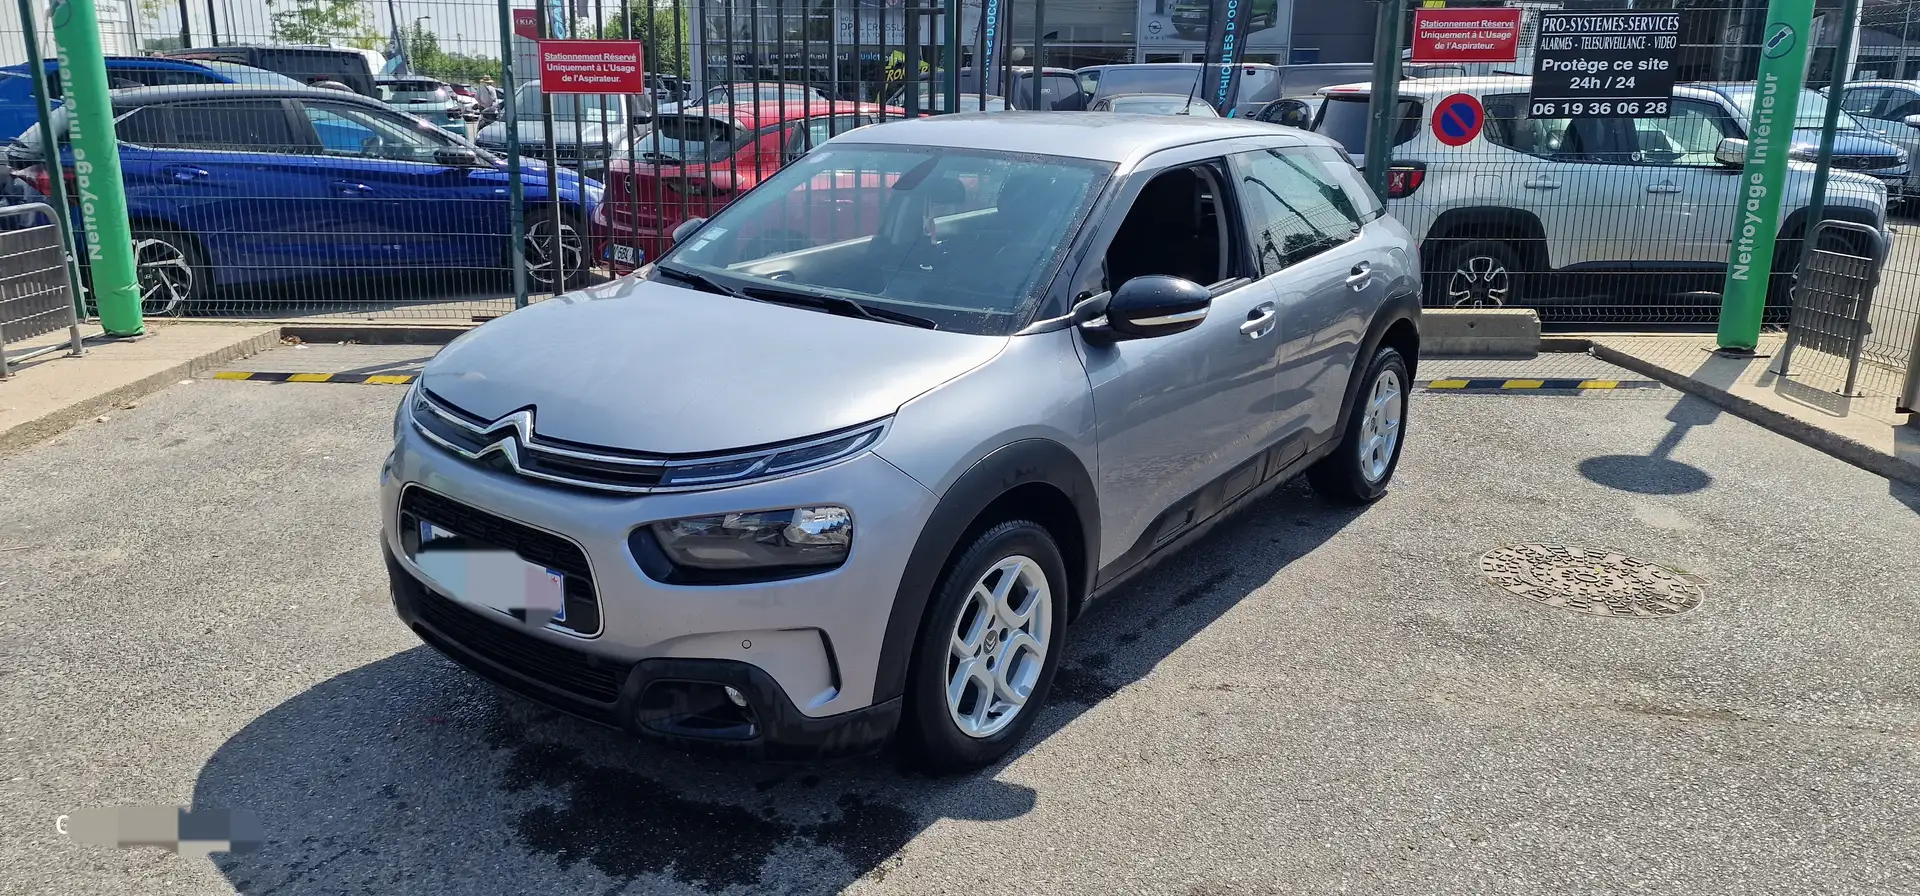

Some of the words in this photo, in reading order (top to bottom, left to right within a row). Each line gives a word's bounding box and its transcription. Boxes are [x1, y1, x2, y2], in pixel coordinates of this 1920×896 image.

[1420, 19, 1480, 28] Stationnement
[1481, 19, 1515, 28] Réservé
[1542, 16, 1680, 32] PRO-SYSTEMES-SERVICES
[1421, 30, 1471, 40] Uniquement
[1478, 31, 1512, 40] L'Usage
[1434, 42, 1445, 50] de
[1446, 42, 1495, 51] l'Aspirateur.
[1540, 36, 1573, 50] ALARMES
[1581, 36, 1646, 50] TELESURVEILLANCE
[1654, 36, 1677, 49] VIDEO
[546, 63, 595, 72] Uniquement
[603, 64, 636, 73] L'Usage
[1218, 33, 1234, 105] VÉHICULES
[1542, 58, 1609, 74] Protège
[1613, 61, 1634, 71] ce
[1638, 57, 1669, 71] site
[561, 74, 573, 82] de
[574, 74, 621, 83] l'Aspirateur.
[1569, 76, 1601, 89] 24h
[1615, 76, 1636, 89] 24
[1532, 103, 1555, 115] 06
[1561, 103, 1583, 115] 19
[1588, 102, 1611, 114] 36
[1616, 102, 1639, 114] 06
[1644, 102, 1667, 114] 28
[1732, 172, 1767, 281] Nettoyage
[1750, 72, 1778, 165] Intérieur
[74, 148, 103, 260] Nettoyage
